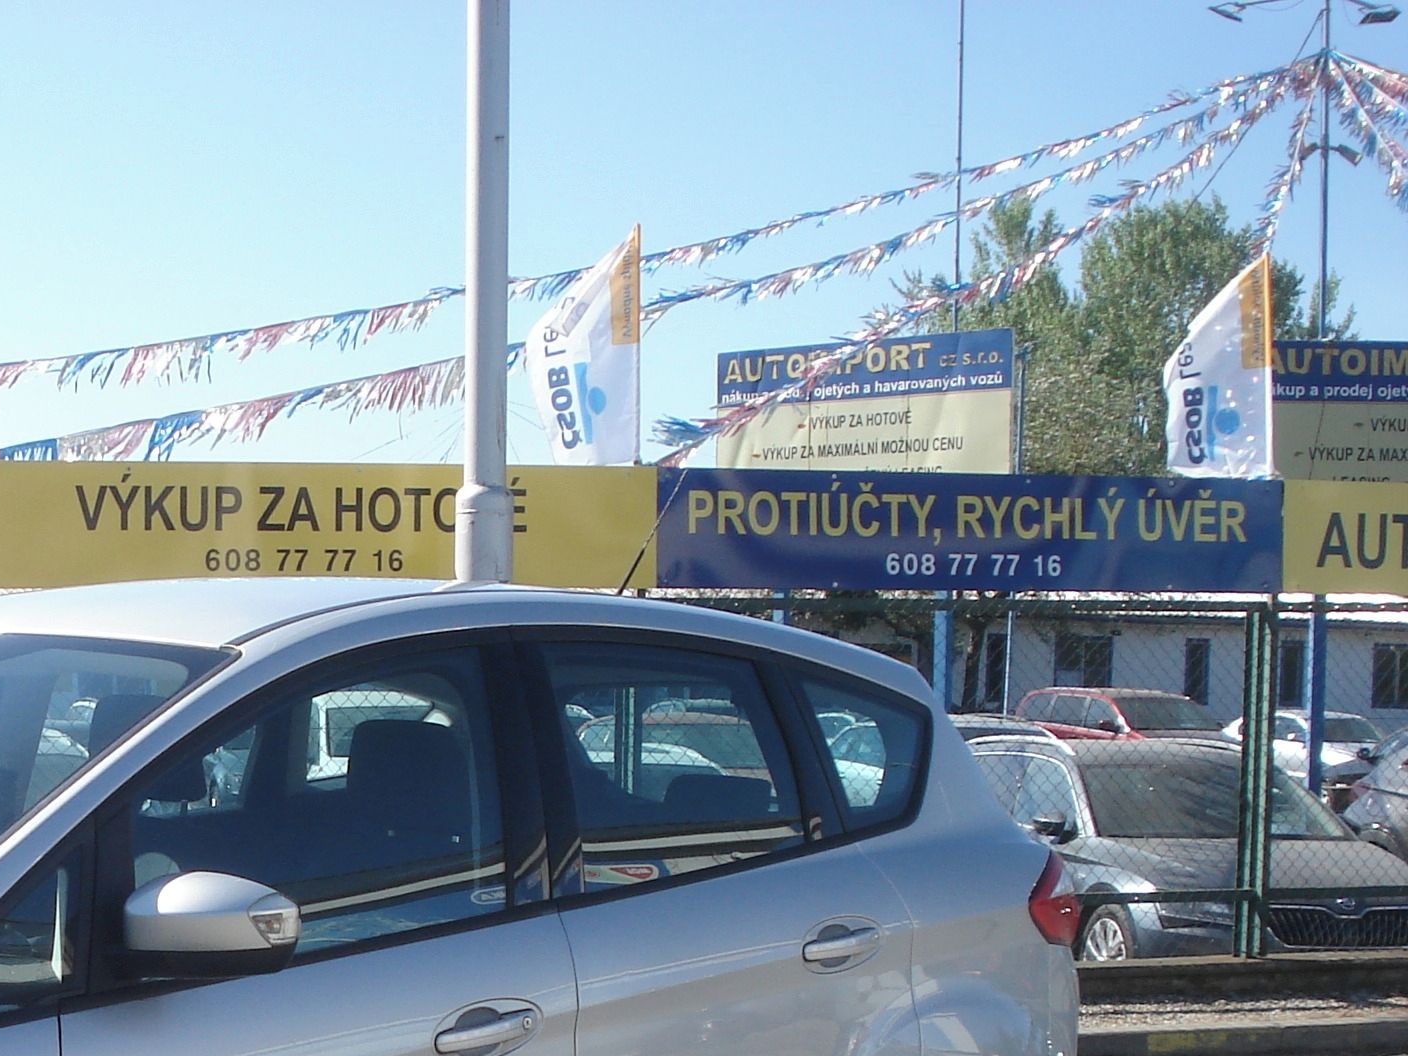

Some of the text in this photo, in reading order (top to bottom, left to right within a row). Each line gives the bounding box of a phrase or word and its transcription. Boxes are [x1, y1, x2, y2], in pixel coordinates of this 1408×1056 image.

[723, 342, 1004, 384] AUTOPORT cz s.r.o.
[814, 382, 859, 400] ojetých
[863, 385, 871, 394] a
[875, 375, 966, 393] havarovaných
[970, 371, 1003, 385] vozů
[1310, 386, 1318, 396] a
[1324, 384, 1372, 399] prodej
[811, 410, 912, 430] VÝKUP ZA HOTOVÉ
[763, 436, 964, 461] VÝKUP ZA MAXIMÁLNÍ MOŽNOU CENU
[1309, 443, 1353, 461] VÝKUP
[1357, 447, 1376, 461] ZA
[75, 473, 527, 532] VÝKUP ZA HOTOÉ
[688, 482, 1247, 546] PROTIÚČTY, RYCHLÝ ÚVĚR
[205, 549, 404, 572] 608 77 77 16
[886, 553, 1062, 577] 608 77 77 16
